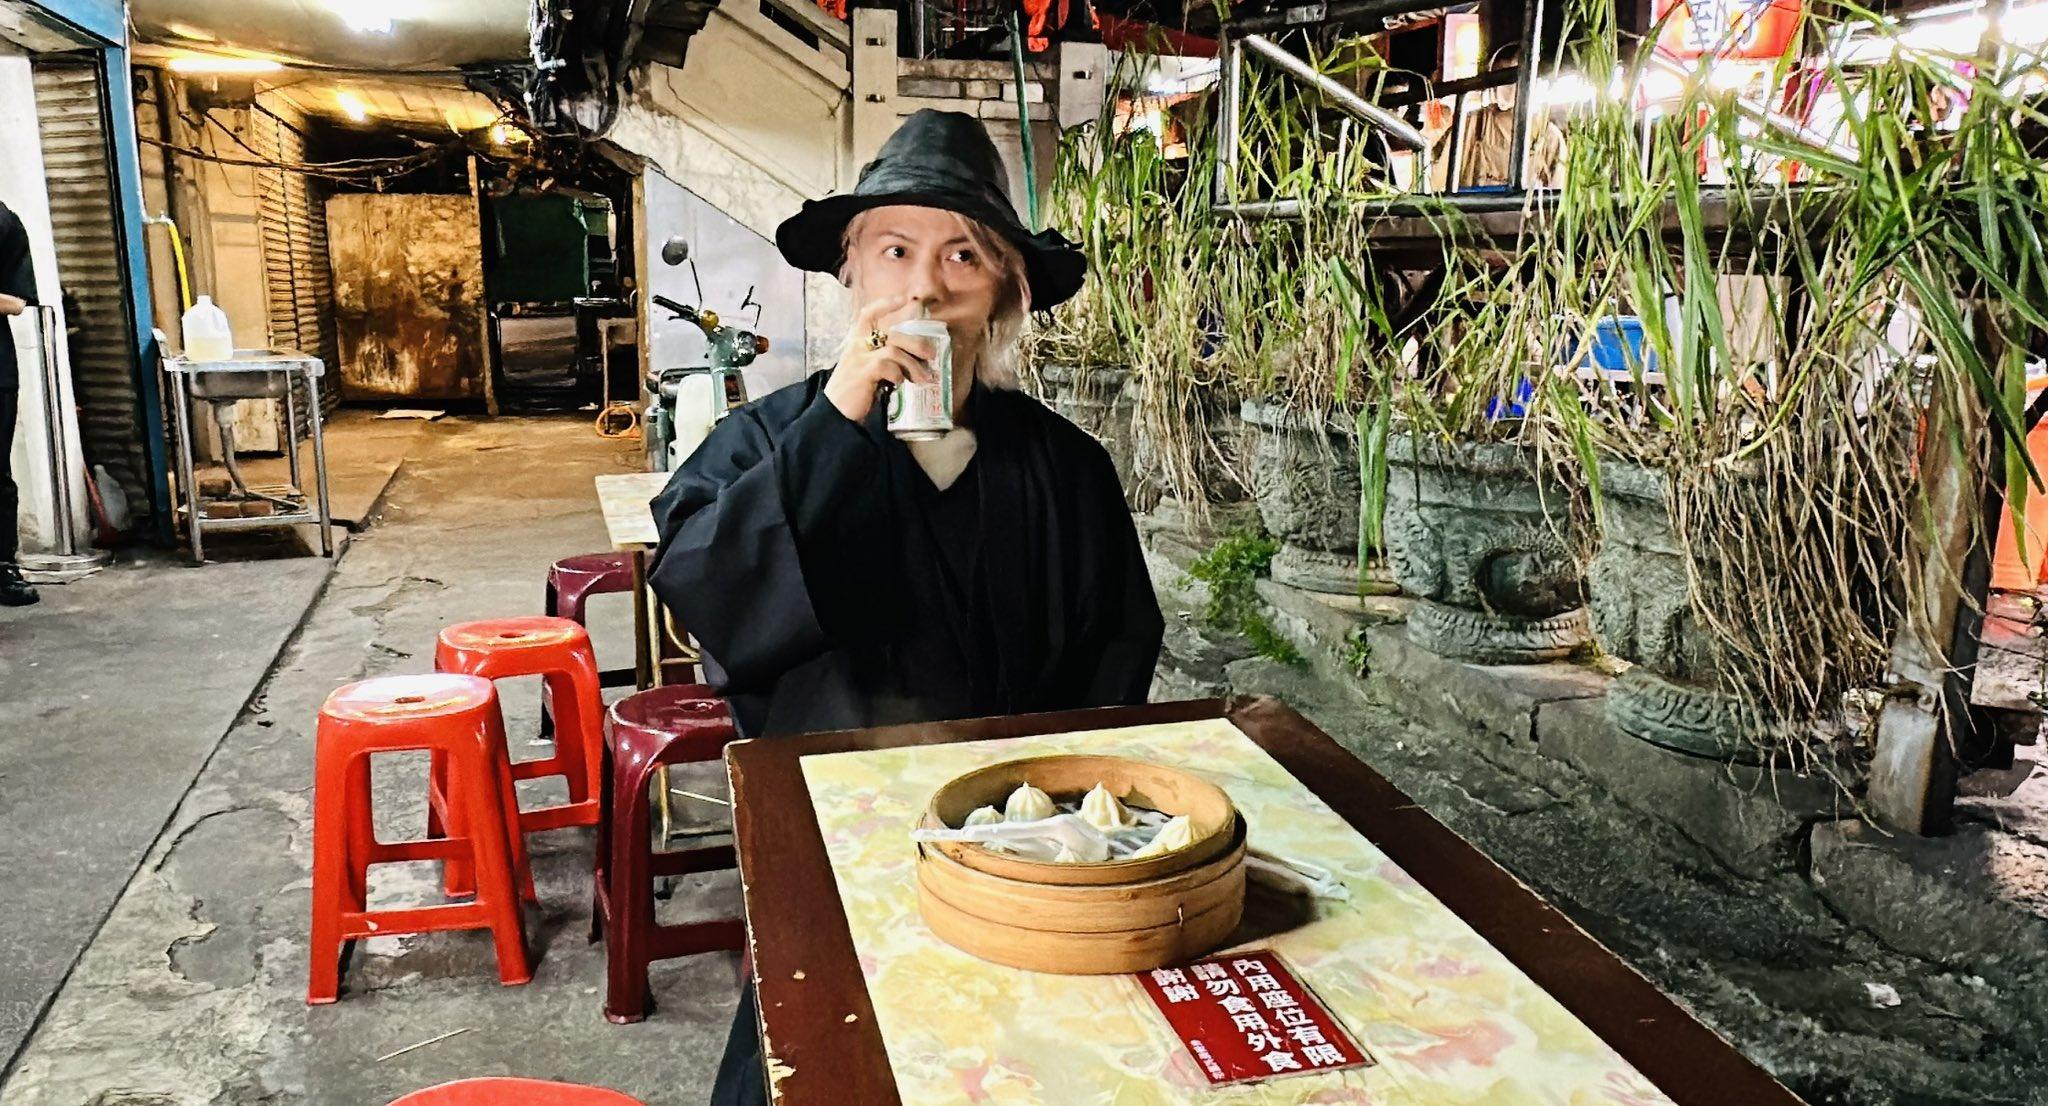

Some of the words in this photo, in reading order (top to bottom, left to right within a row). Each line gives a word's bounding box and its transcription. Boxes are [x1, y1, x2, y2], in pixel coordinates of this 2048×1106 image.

[1151, 967, 1200, 1003] 謝謝
[1190, 962, 1302, 1072] 請勿食用外食
[1232, 959, 1346, 1066] 內用座位有限
